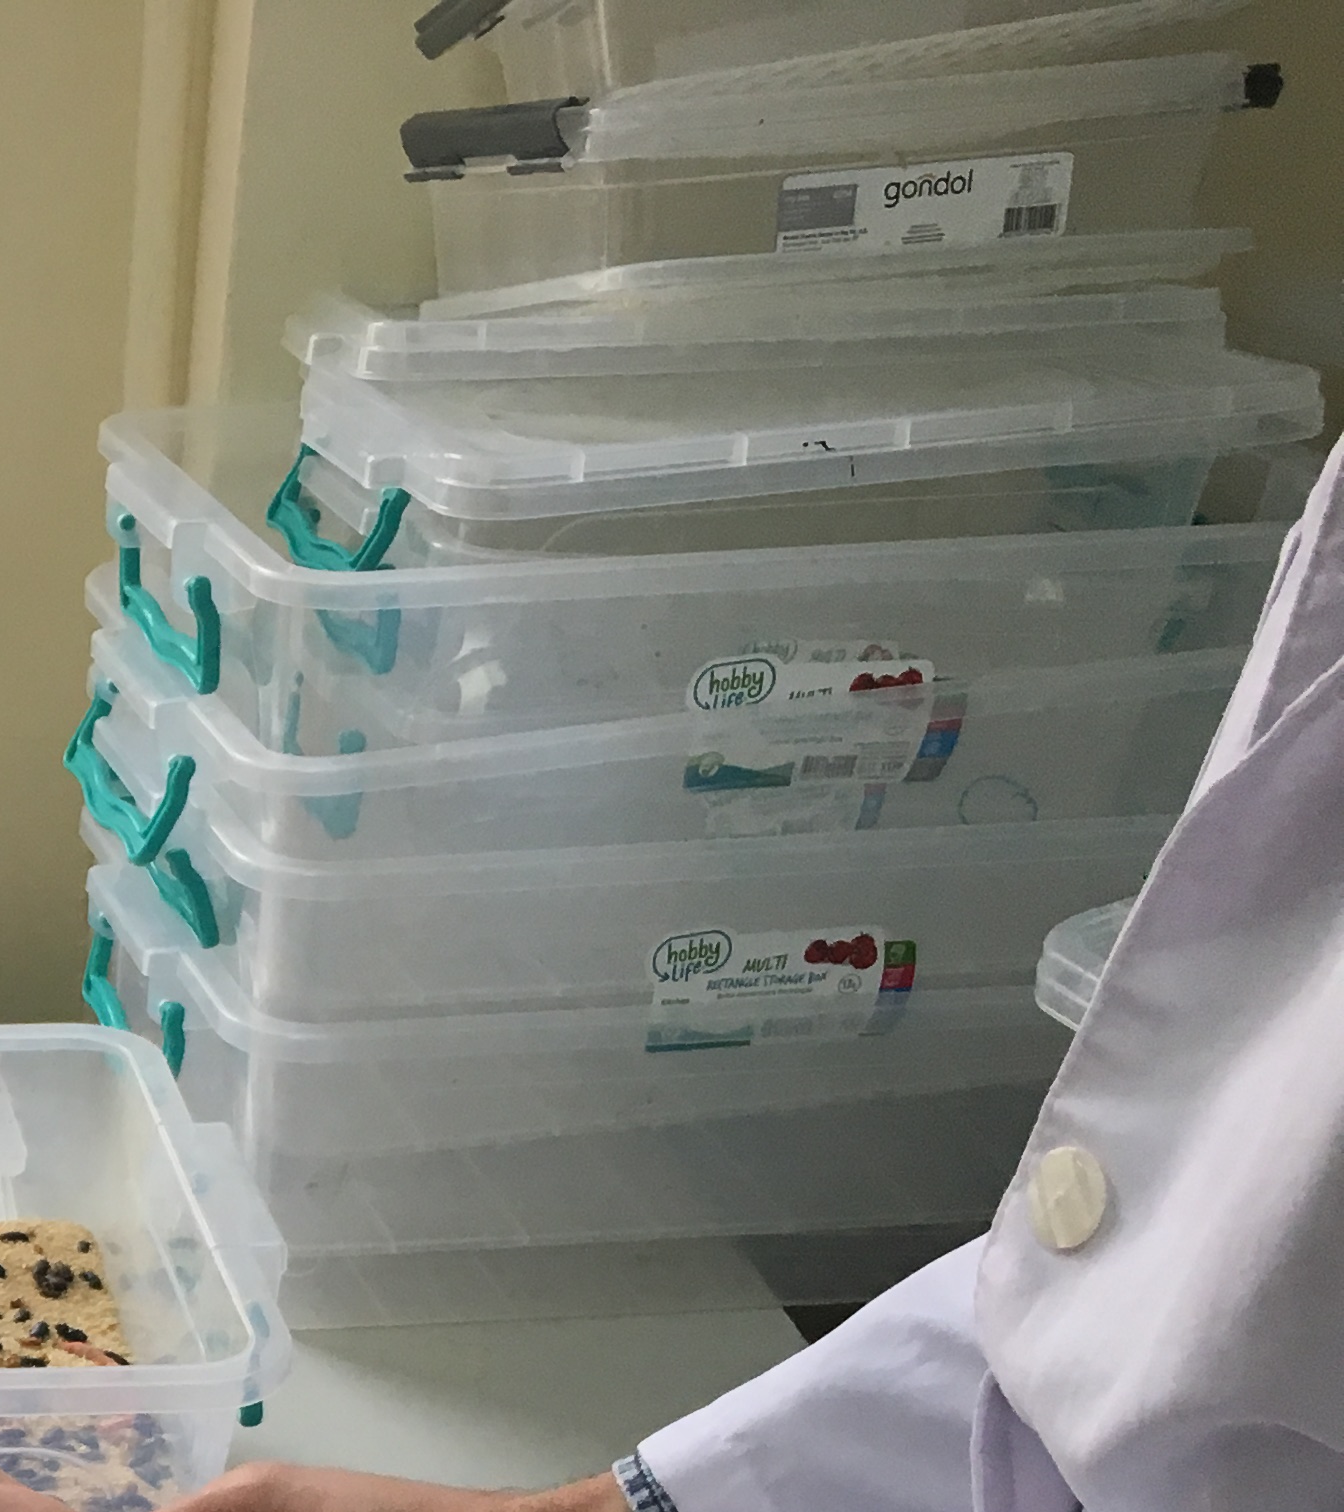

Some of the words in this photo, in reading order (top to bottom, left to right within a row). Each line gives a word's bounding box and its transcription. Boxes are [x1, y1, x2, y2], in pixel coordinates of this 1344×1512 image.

[884, 168, 973, 208] gondol
[708, 665, 764, 698] hobby
[667, 937, 721, 967] hobby
[742, 953, 789, 973] MULTI
